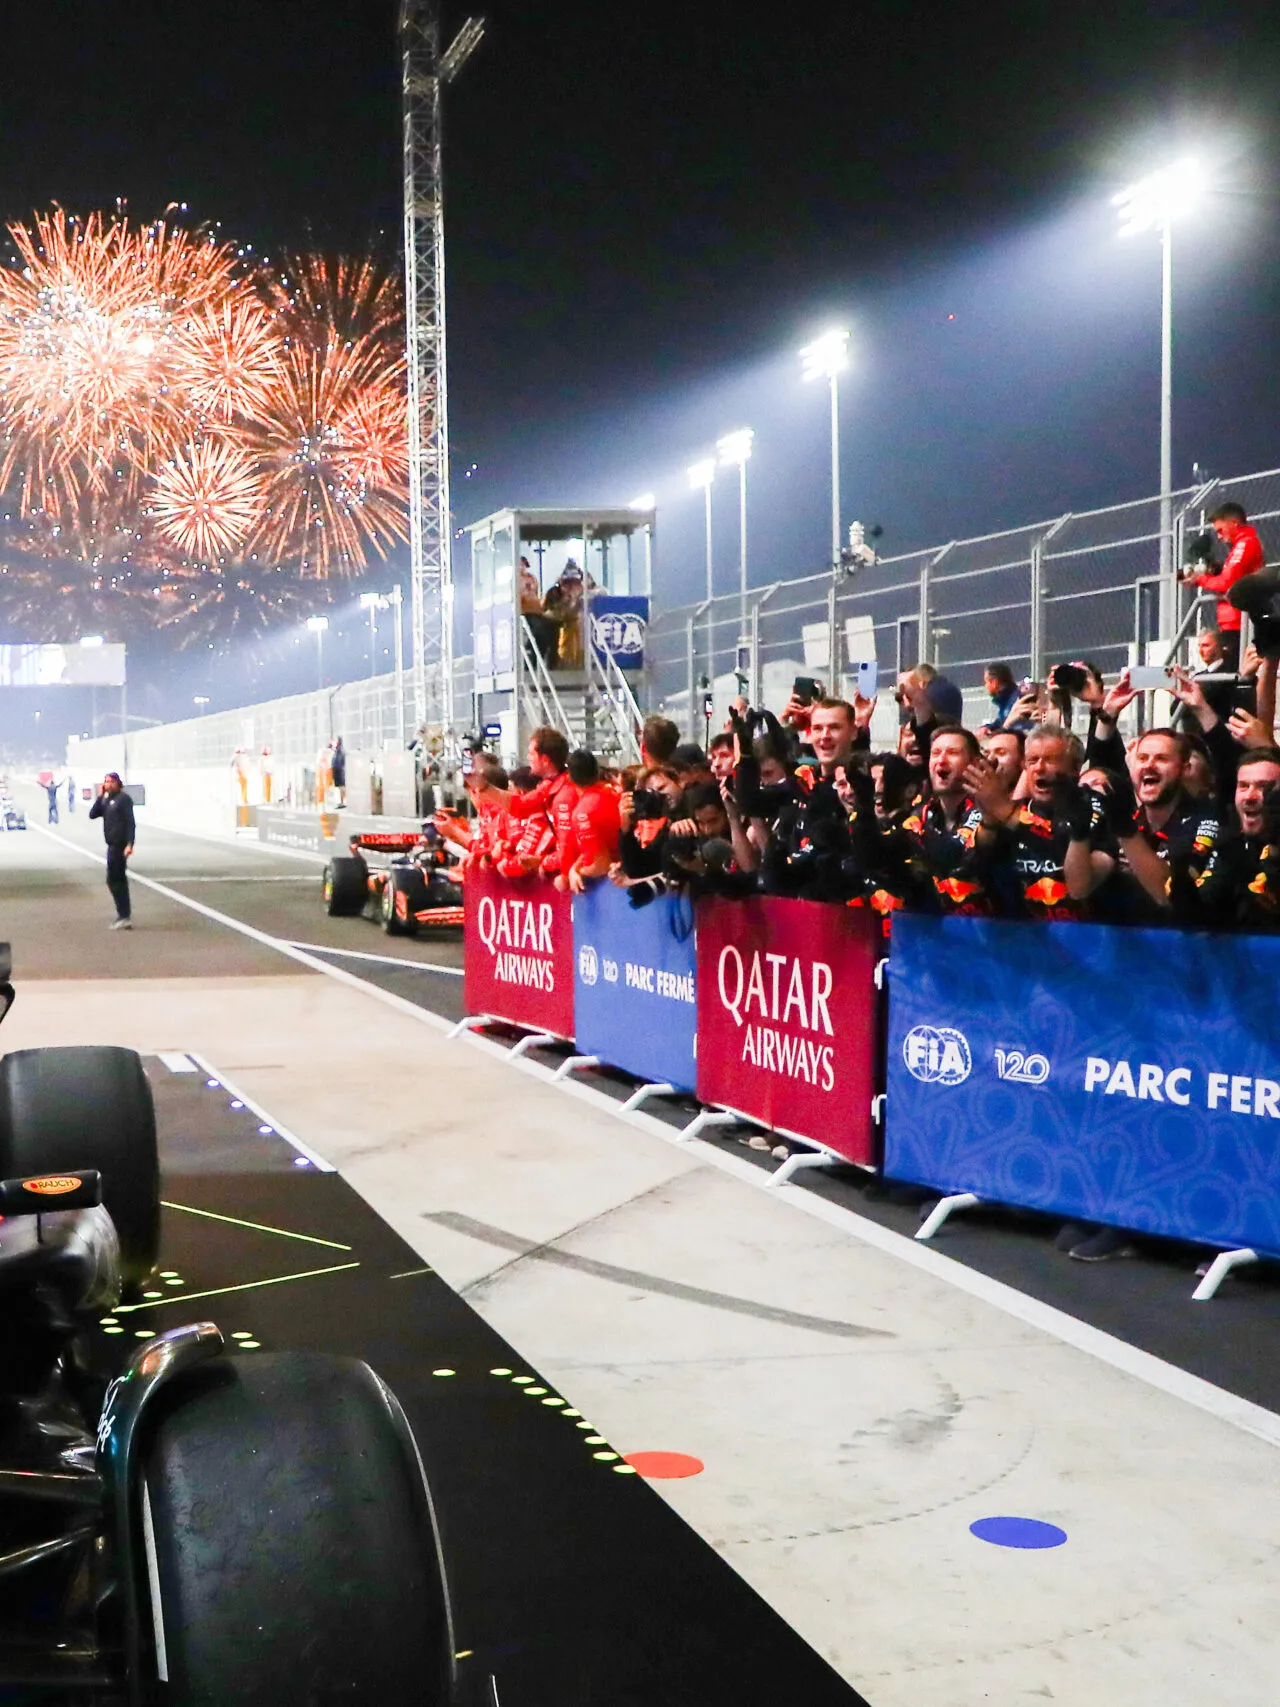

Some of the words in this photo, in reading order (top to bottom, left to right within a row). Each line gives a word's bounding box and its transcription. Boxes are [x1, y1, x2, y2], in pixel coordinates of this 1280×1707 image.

[593, 617, 645, 650] FIA
[478, 896, 554, 955] QATAR
[494, 951, 555, 992] AIRWAYS
[626, 963, 654, 993] PARC
[657, 970, 695, 1003] FERMÉ
[718, 944, 834, 1037] QATAR
[742, 1025, 835, 1092] AIRWAYS
[994, 1048, 1050, 1084] 120
[1085, 1057, 1192, 1106] PARC
[1208, 1072, 1280, 1119] FER
[38, 1180, 74, 1189] RAUCH
